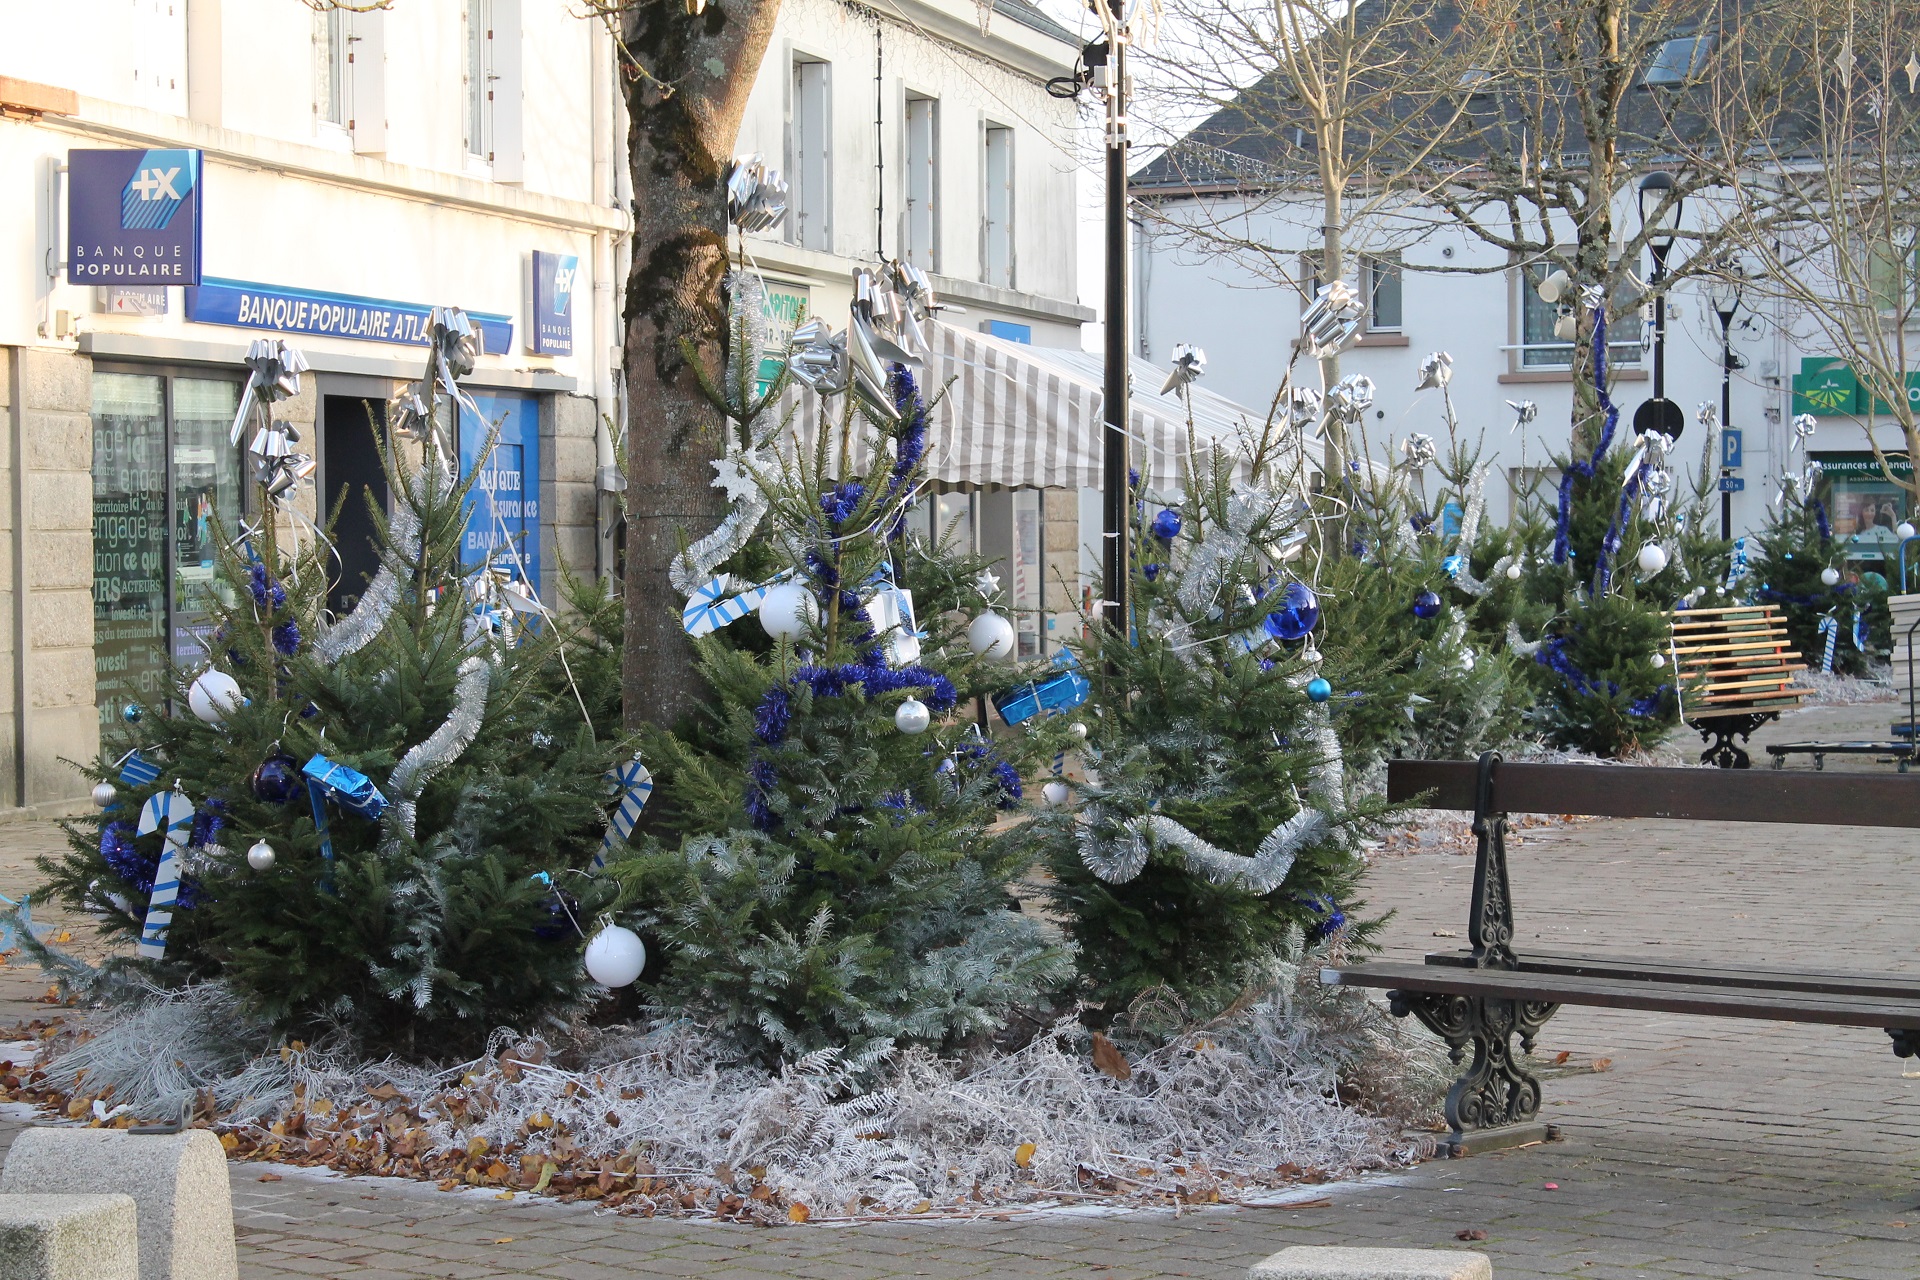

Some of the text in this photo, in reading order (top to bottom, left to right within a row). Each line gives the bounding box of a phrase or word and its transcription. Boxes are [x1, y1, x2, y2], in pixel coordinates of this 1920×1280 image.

[77, 246, 181, 258] BANQUE
[76, 264, 182, 276] POPULAIRE
[761, 284, 807, 323] APITOLE
[238, 294, 430, 342] BANQUE POPULAIRE ATLA
[542, 324, 570, 335] BANQUE
[542, 338, 571, 350] POPULAIRE
[127, 425, 146, 462] ici
[1727, 436, 1737, 461] P
[1869, 461, 1880, 470] et
[1725, 480, 1733, 488] 50
[489, 500, 537, 518] ssurance
[94, 546, 121, 572] tion
[123, 552, 137, 571] ce
[141, 545, 161, 577] qui
[121, 579, 161, 593] ACTEURS
[111, 604, 136, 621] investi
[105, 627, 115, 640] du
[116, 625, 152, 640] territoire
